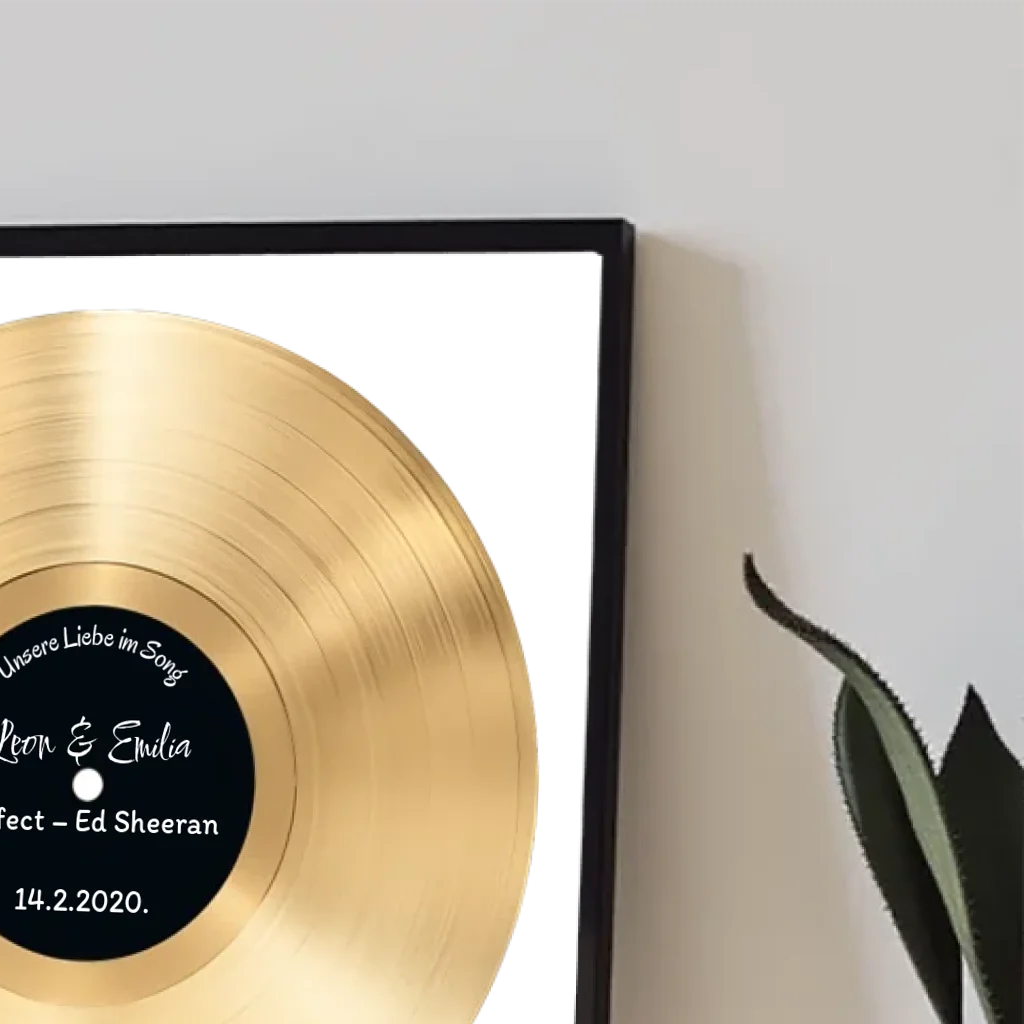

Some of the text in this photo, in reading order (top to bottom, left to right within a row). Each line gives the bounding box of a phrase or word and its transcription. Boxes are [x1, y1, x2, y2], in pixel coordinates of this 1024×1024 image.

[63, 624, 114, 650] Liebe
[118, 628, 138, 653] im
[140, 640, 188, 687] Song
[67, 715, 98, 766] &
[107, 720, 192, 764] Emilia
[75, 809, 107, 833] Ed
[114, 809, 219, 835] Sheeran
[14, 887, 149, 914] 14.2.2020.
